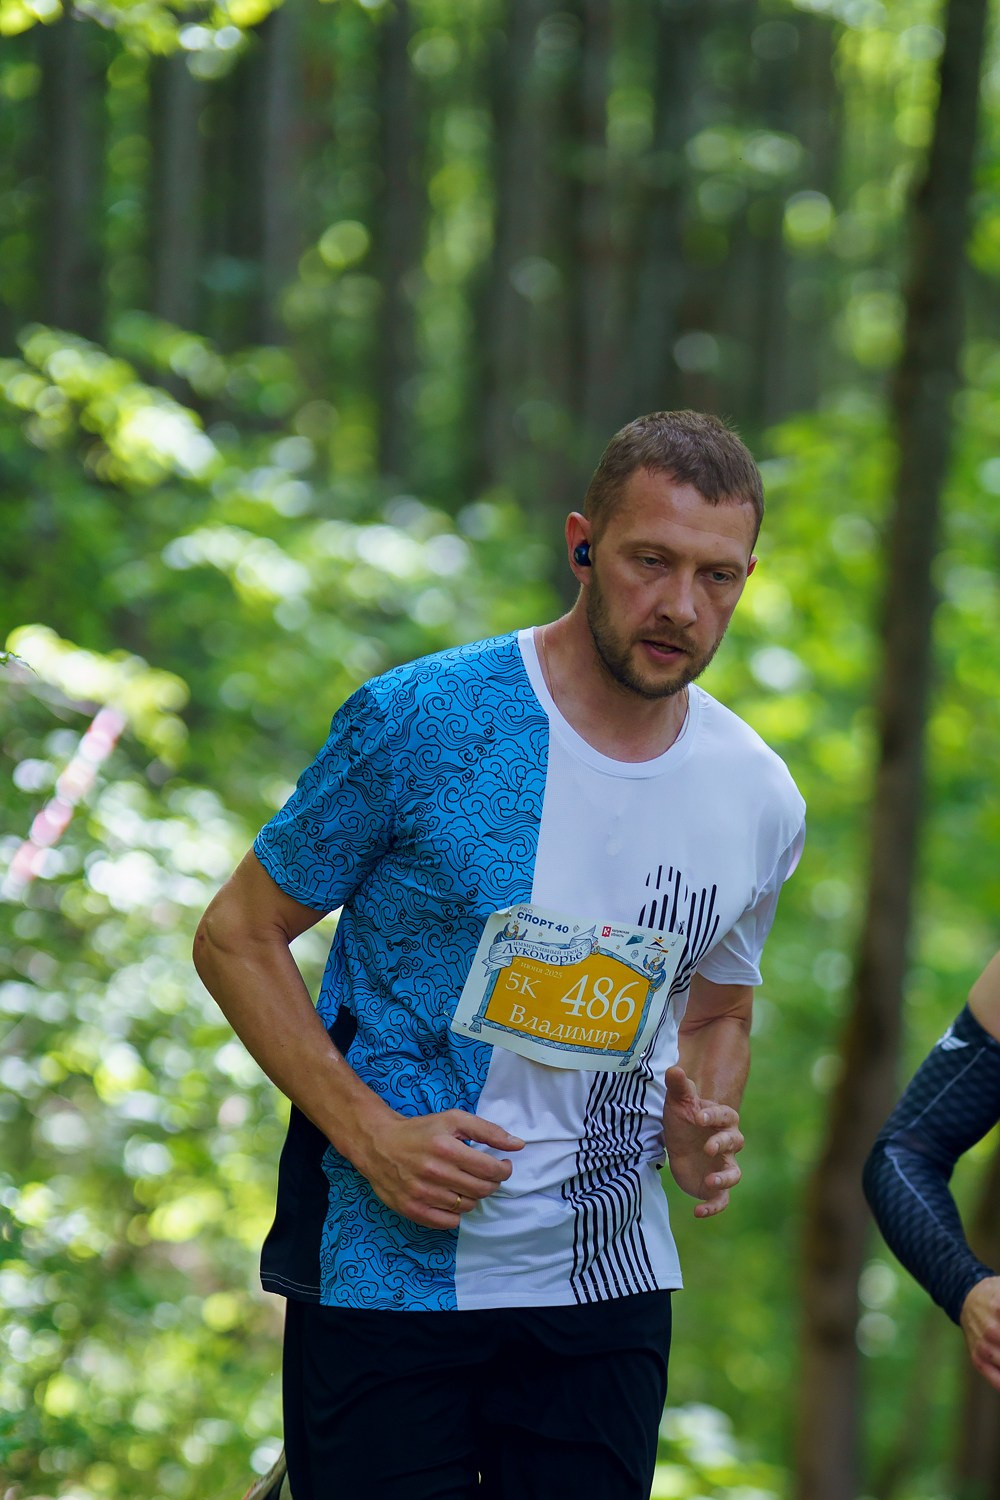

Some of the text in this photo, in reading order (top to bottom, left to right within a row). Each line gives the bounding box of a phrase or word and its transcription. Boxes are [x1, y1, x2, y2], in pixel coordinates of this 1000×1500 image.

[517, 911, 569, 934] СПОРТ 40
[502, 943, 583, 967] Лукоморье
[544, 968, 563, 979] 2025
[560, 974, 640, 1023] 486
[508, 1003, 621, 1050] Владимир
